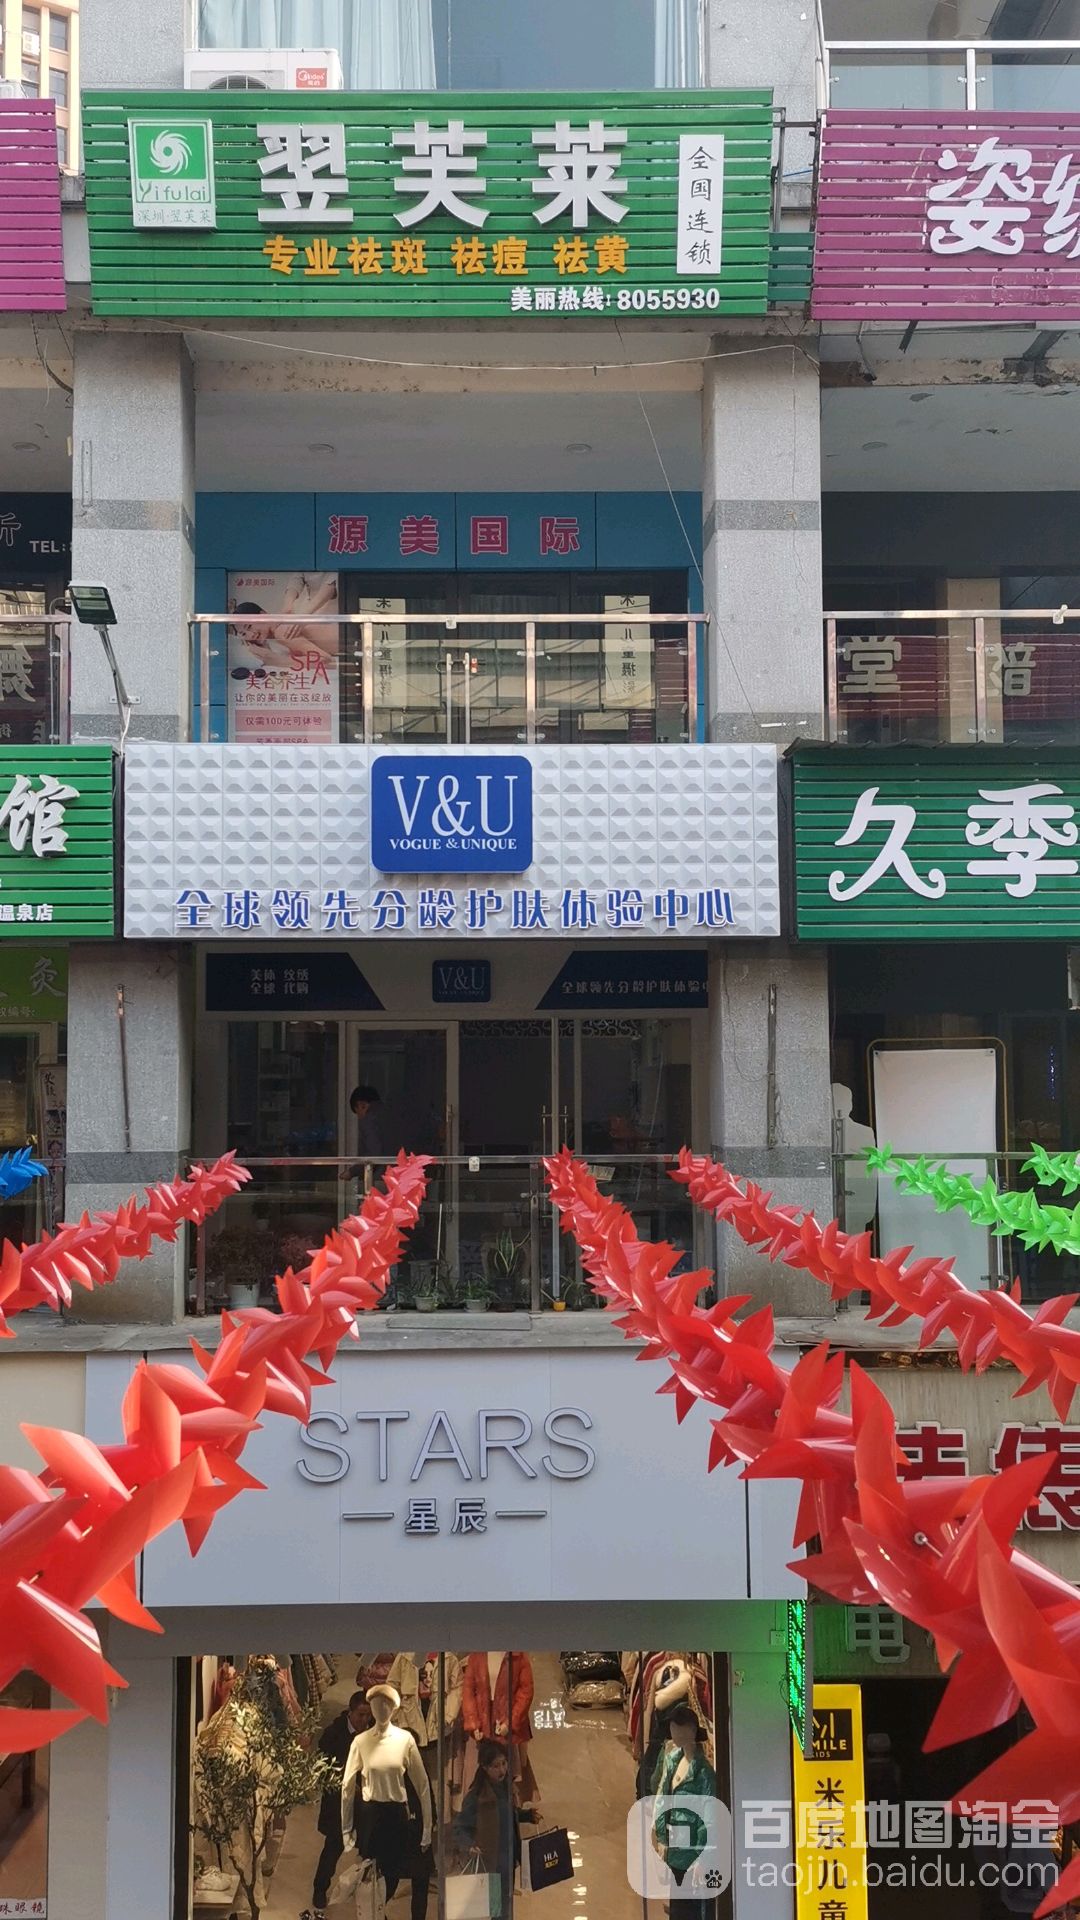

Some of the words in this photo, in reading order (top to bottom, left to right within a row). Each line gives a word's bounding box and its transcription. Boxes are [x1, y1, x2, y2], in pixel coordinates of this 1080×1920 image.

[139, 181, 206, 203] Yifulai
[256, 120, 630, 229] 翌芙莱
[685, 145, 714, 267] 全国连锁
[263, 236, 429, 276] 专业祛斑
[451, 236, 529, 276] 祛痘
[553, 236, 629, 276] 祛黄
[29, 540, 72, 554] TEL:
[328, 514, 580, 556] 源美国际
[289, 650, 331, 685] SPA
[245, 716, 322, 726] 仅需100元可体验
[0, 774, 80, 858] 馆
[387, 775, 518, 836] V&U
[389, 838, 441, 850] VOGUE
[445, 837, 459, 849] &
[461, 838, 517, 852] UNIQUE
[828, 785, 1079, 901] 久季
[0, 903, 54, 921] 温泉店
[174, 888, 737, 930] 全球领先分龄护肤体验中心
[439, 966, 486, 990] V&U
[296, 1407, 597, 1484] STARS
[404, 1497, 489, 1535] 星辰
[543, 1850, 559, 1863] HLA
